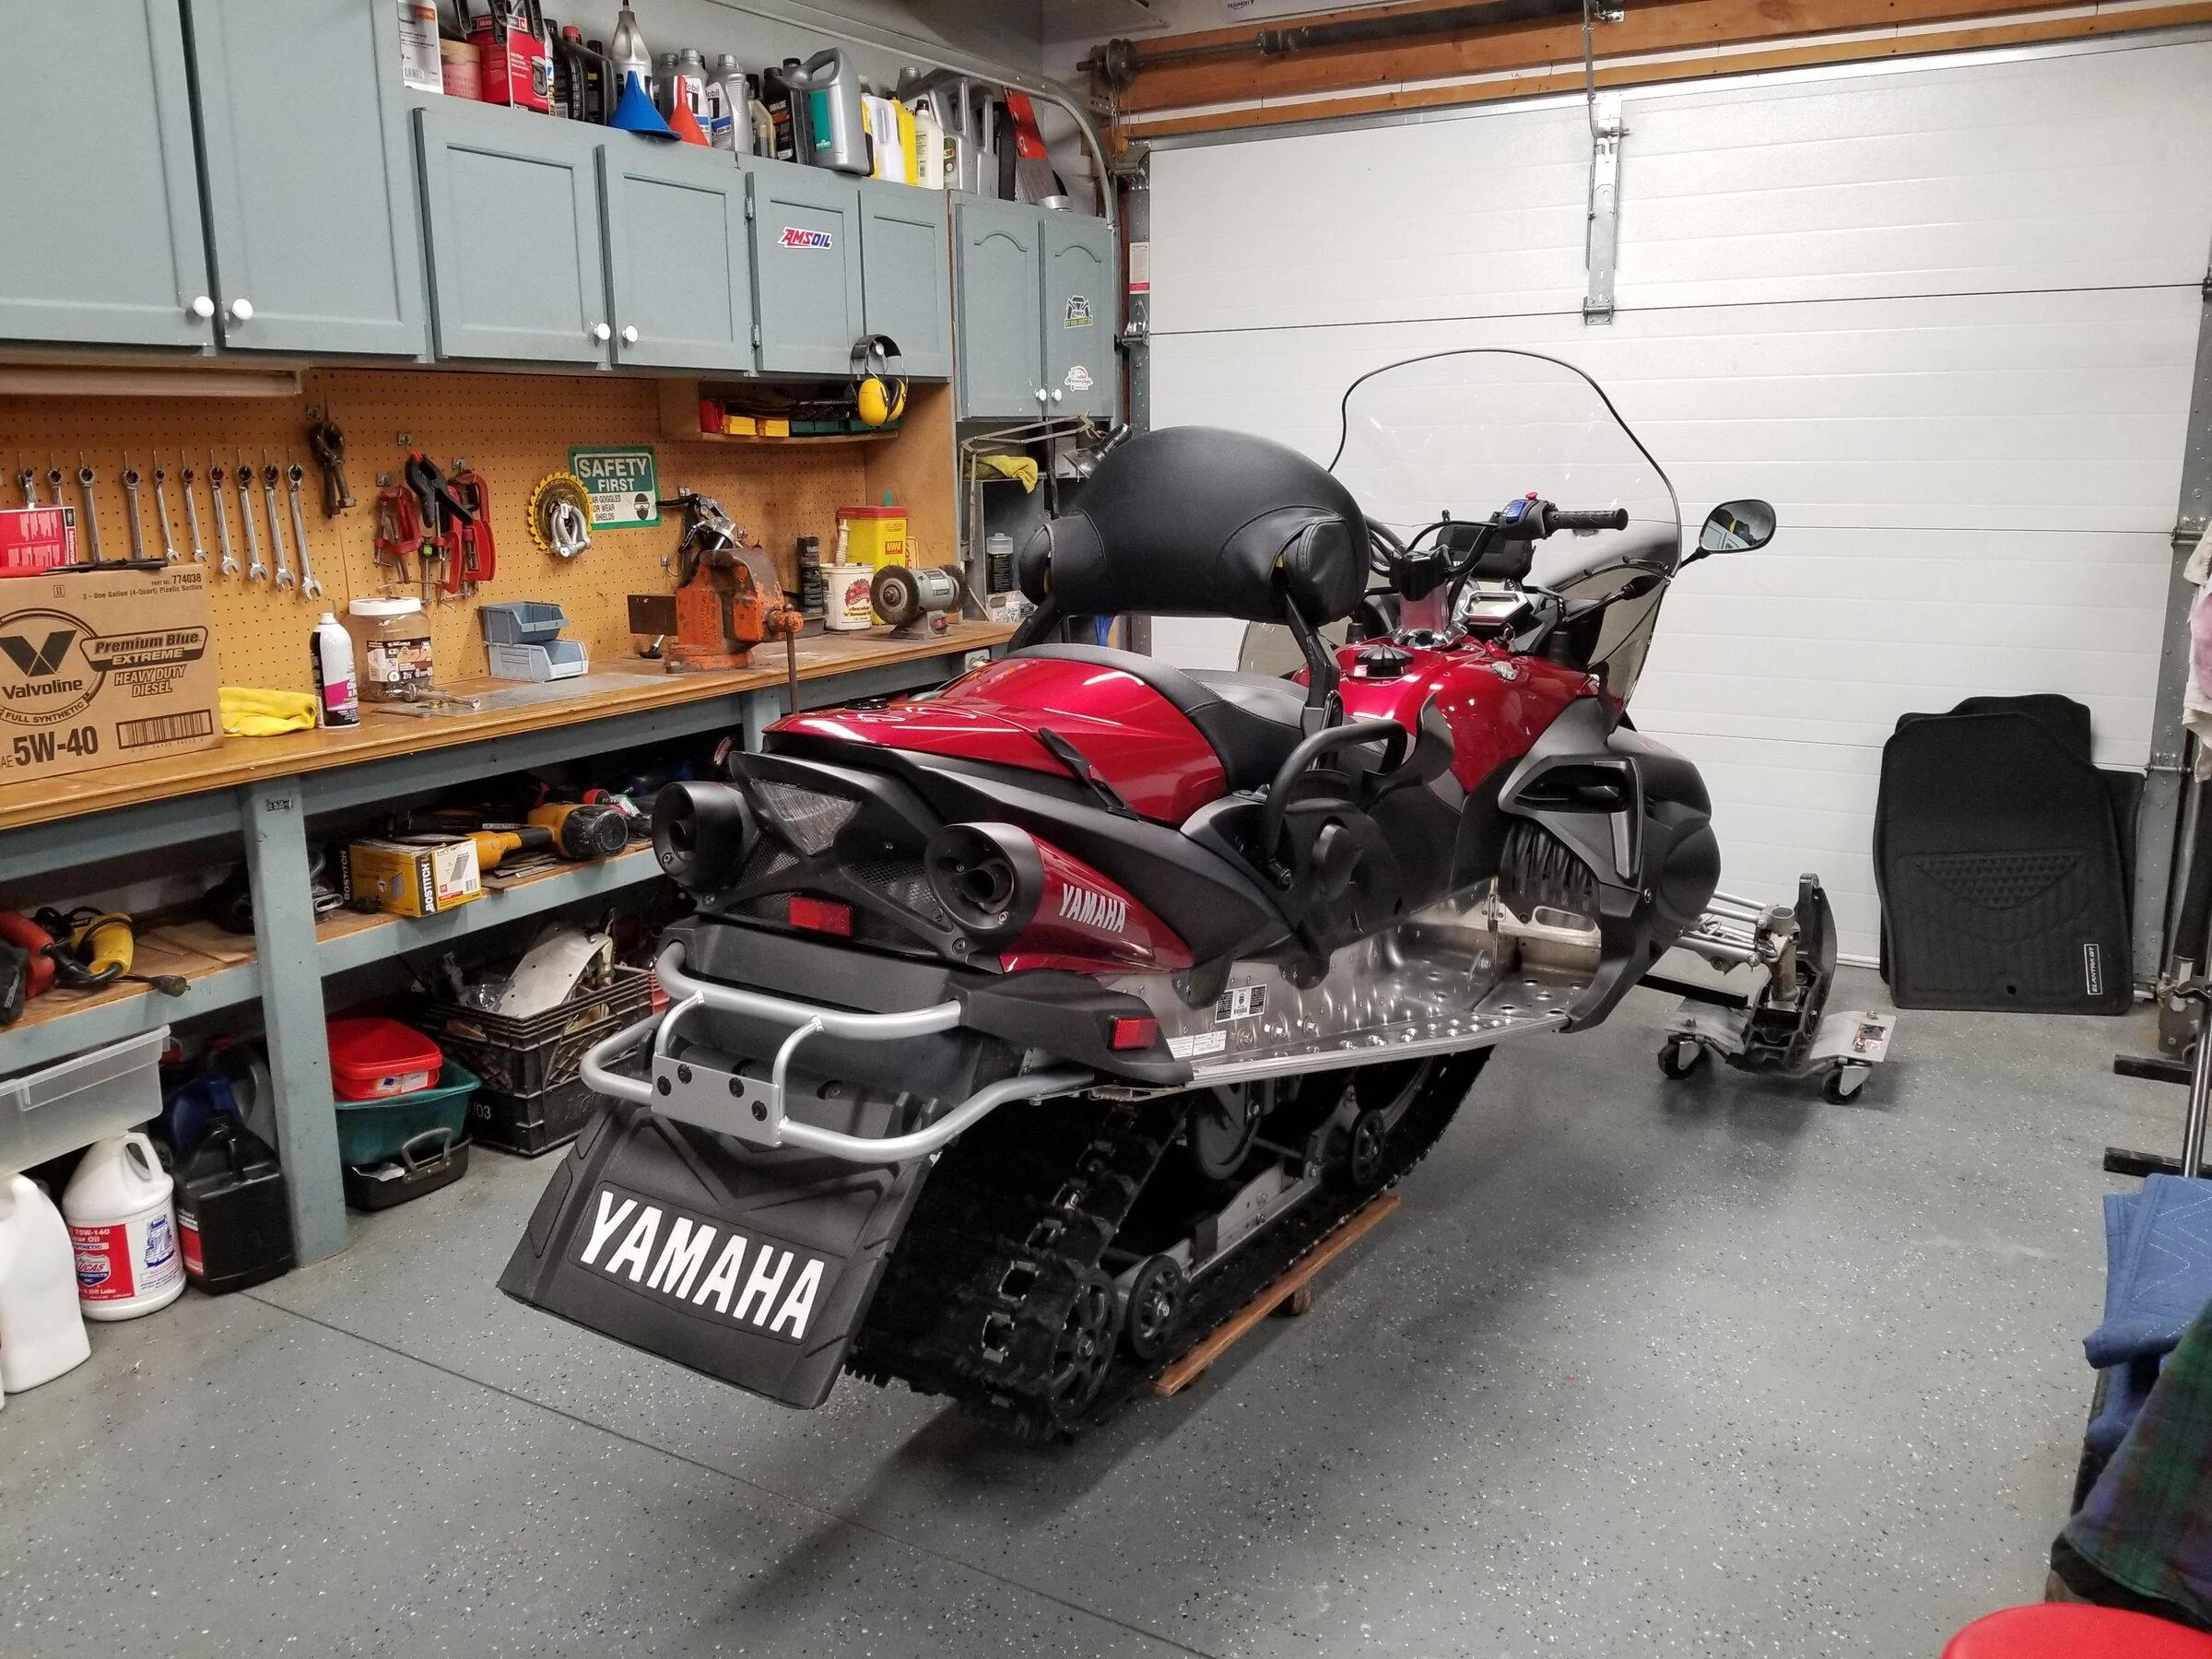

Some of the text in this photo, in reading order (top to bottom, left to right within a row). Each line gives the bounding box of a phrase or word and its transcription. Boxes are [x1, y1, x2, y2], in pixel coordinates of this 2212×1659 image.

[686, 82, 700, 93] obil
[707, 88, 720, 98] obil
[781, 228, 831, 248] AMSOIL
[578, 458, 647, 478] SAFETY
[597, 477, 635, 492] FIRST
[599, 494, 622, 503] GOGGLES
[601, 503, 616, 512] WEAR
[594, 512, 616, 522] SHIELDS
[172, 573, 202, 584] 774038
[159, 585, 180, 594] Plastic
[182, 583, 203, 592] Bottles
[95, 632, 198, 654] Premium Blue
[112, 647, 184, 665] EXTREME
[114, 664, 188, 687] HEAVY DUTY
[2, 679, 84, 700] Valvoline
[131, 680, 173, 698] DIESEL
[5, 701, 85, 724] FULL SYNTHETIC
[0, 725, 99, 769] AE 5W-40
[420, 863, 437, 913] BOSTITCH
[1059, 882, 1126, 934] YAMAHA
[580, 1190, 825, 1339] YAMAHA
